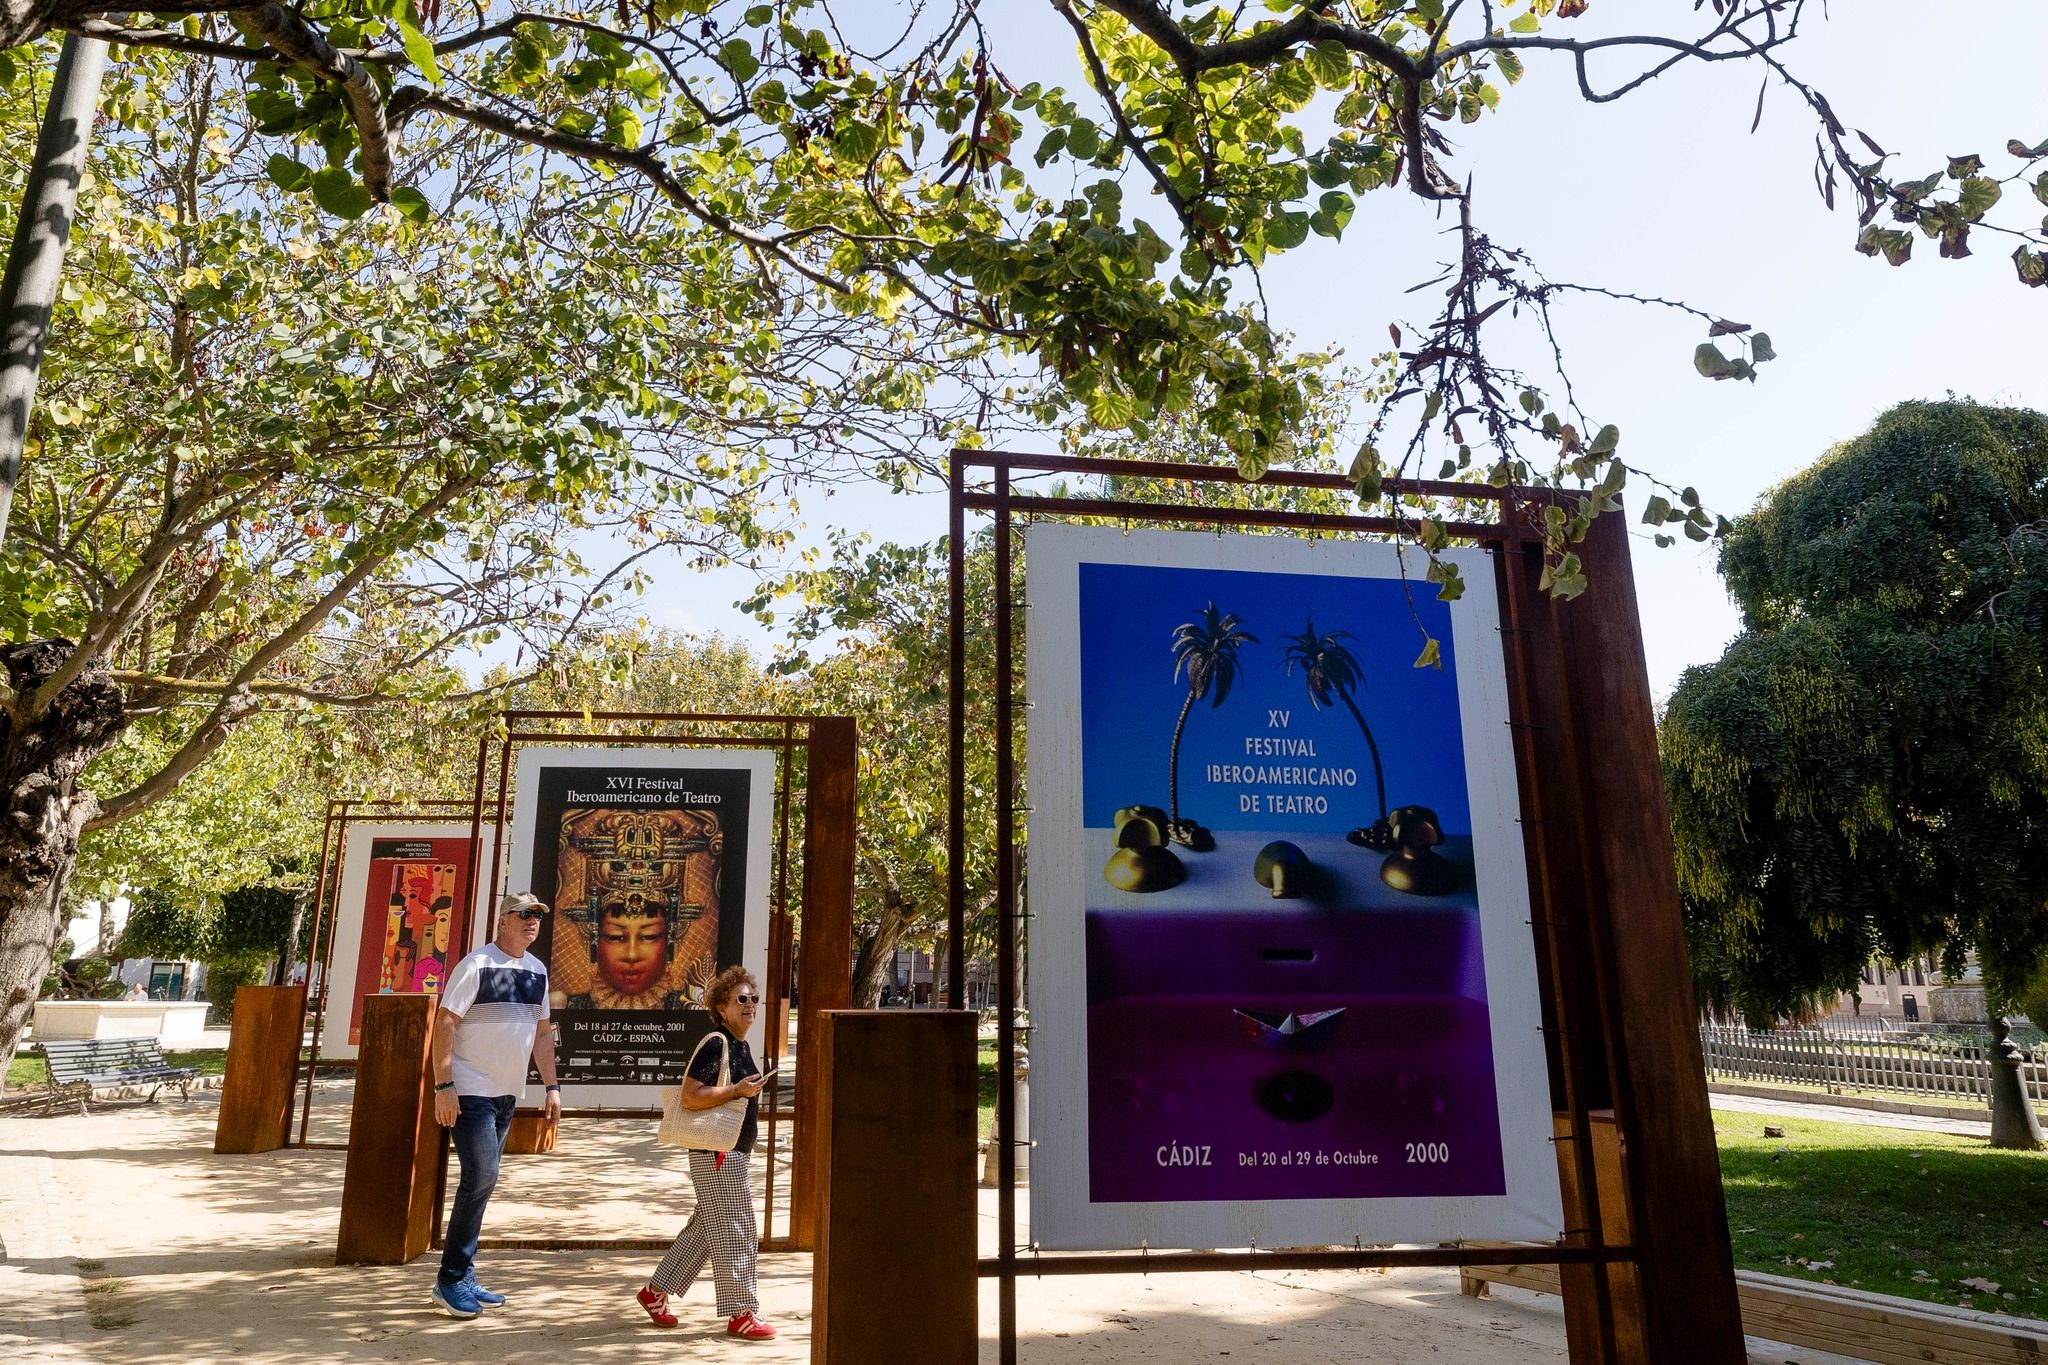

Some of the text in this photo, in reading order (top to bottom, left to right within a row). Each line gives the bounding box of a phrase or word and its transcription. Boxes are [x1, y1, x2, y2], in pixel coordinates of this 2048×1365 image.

[1268, 710, 1290, 728] XV
[1245, 737, 1317, 757] FESTIVAL
[606, 777, 683, 790] XVI Festival
[1207, 765, 1357, 787] IBEROAMERICANO
[567, 790, 721, 804] Iberoamericano de Teatro
[1240, 795, 1328, 814] DE TEATRO
[574, 1022, 685, 1032] Del 18 al 27 de octubre, 2001
[592, 1032, 622, 1043] CÁDIZ
[629, 1032, 666, 1043] ESPAÑA
[1156, 1140, 1450, 1167] CÁDIZ Del 20 al 29 de Octubre 2000
